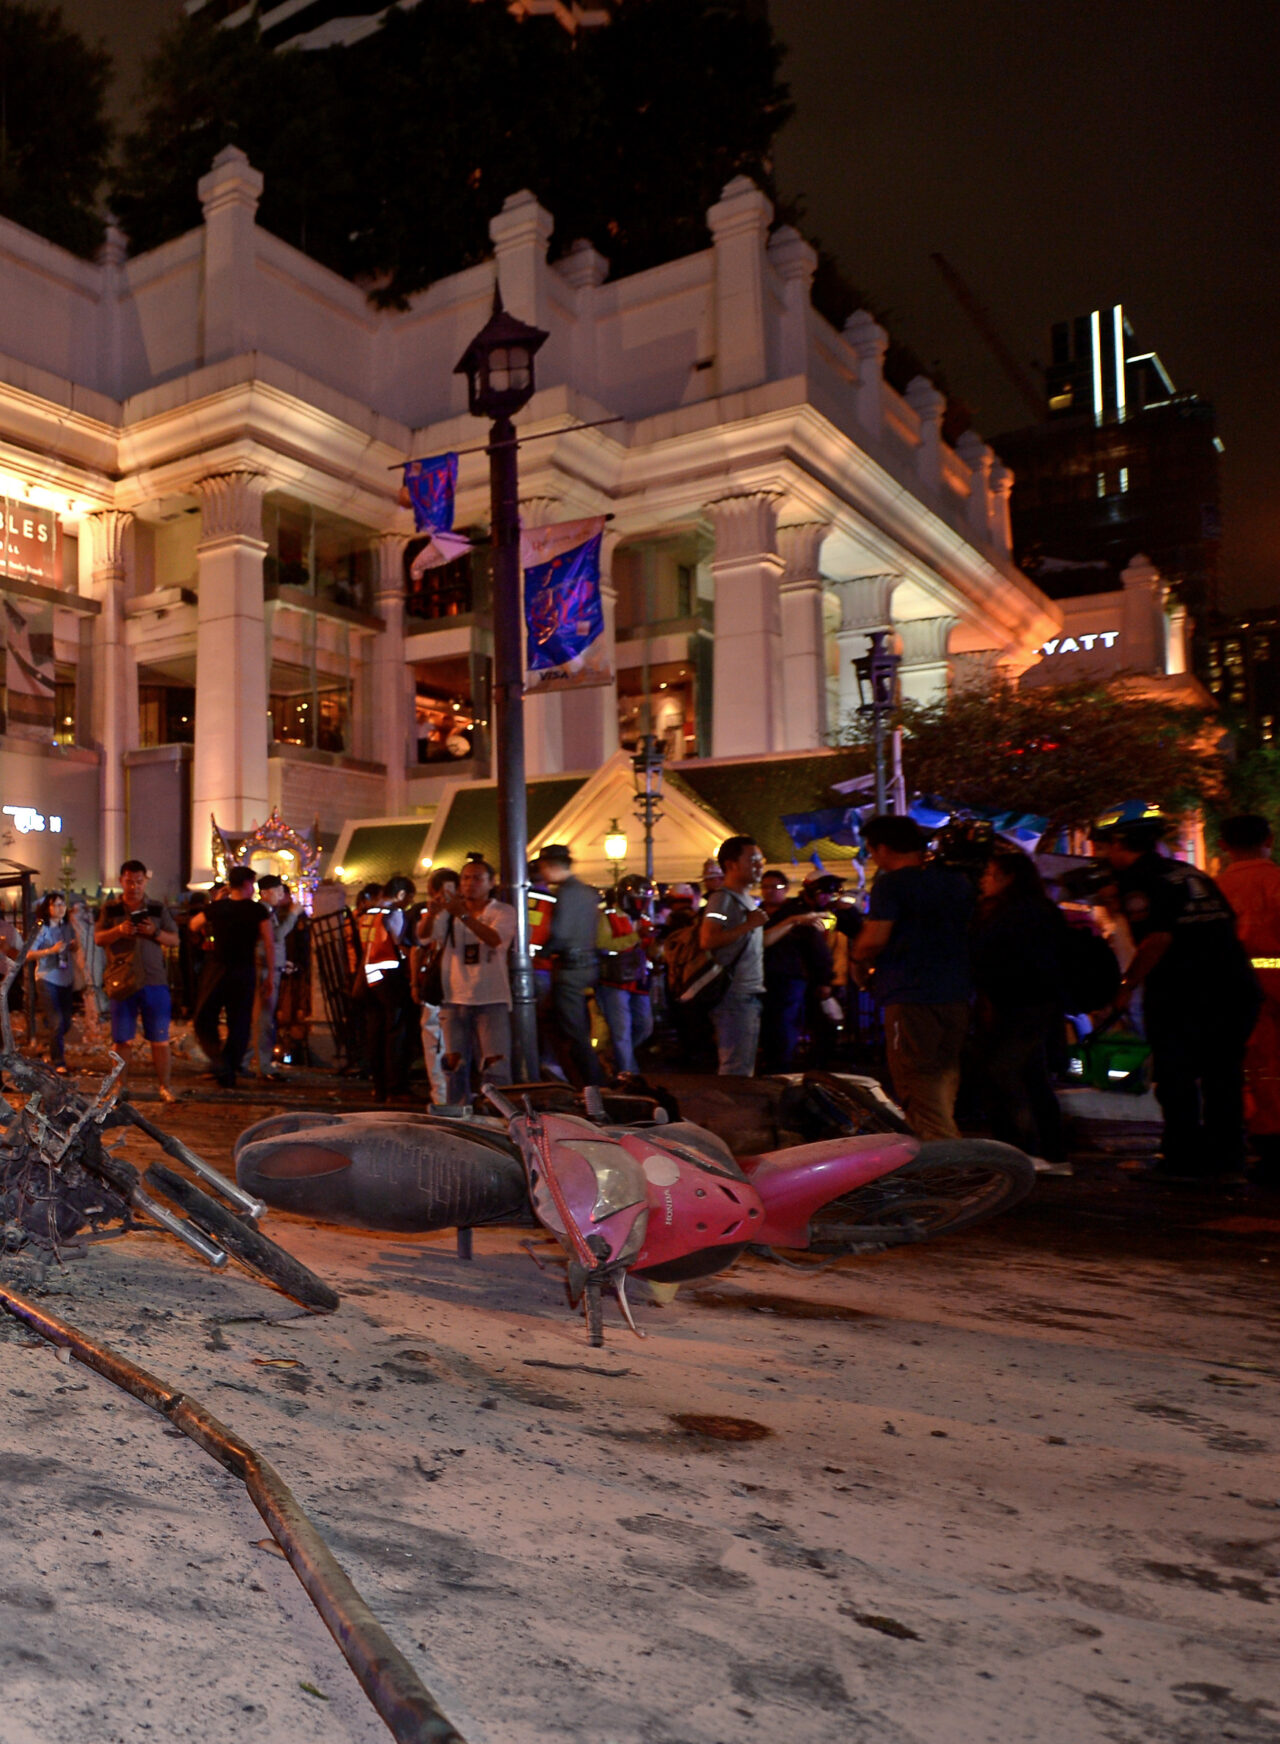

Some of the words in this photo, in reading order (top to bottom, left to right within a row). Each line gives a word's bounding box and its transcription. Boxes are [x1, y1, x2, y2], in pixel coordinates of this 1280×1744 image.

[1032, 631, 1120, 655] YATT
[539, 670, 569, 683] VISA
[663, 1189, 673, 1226] HONDA
